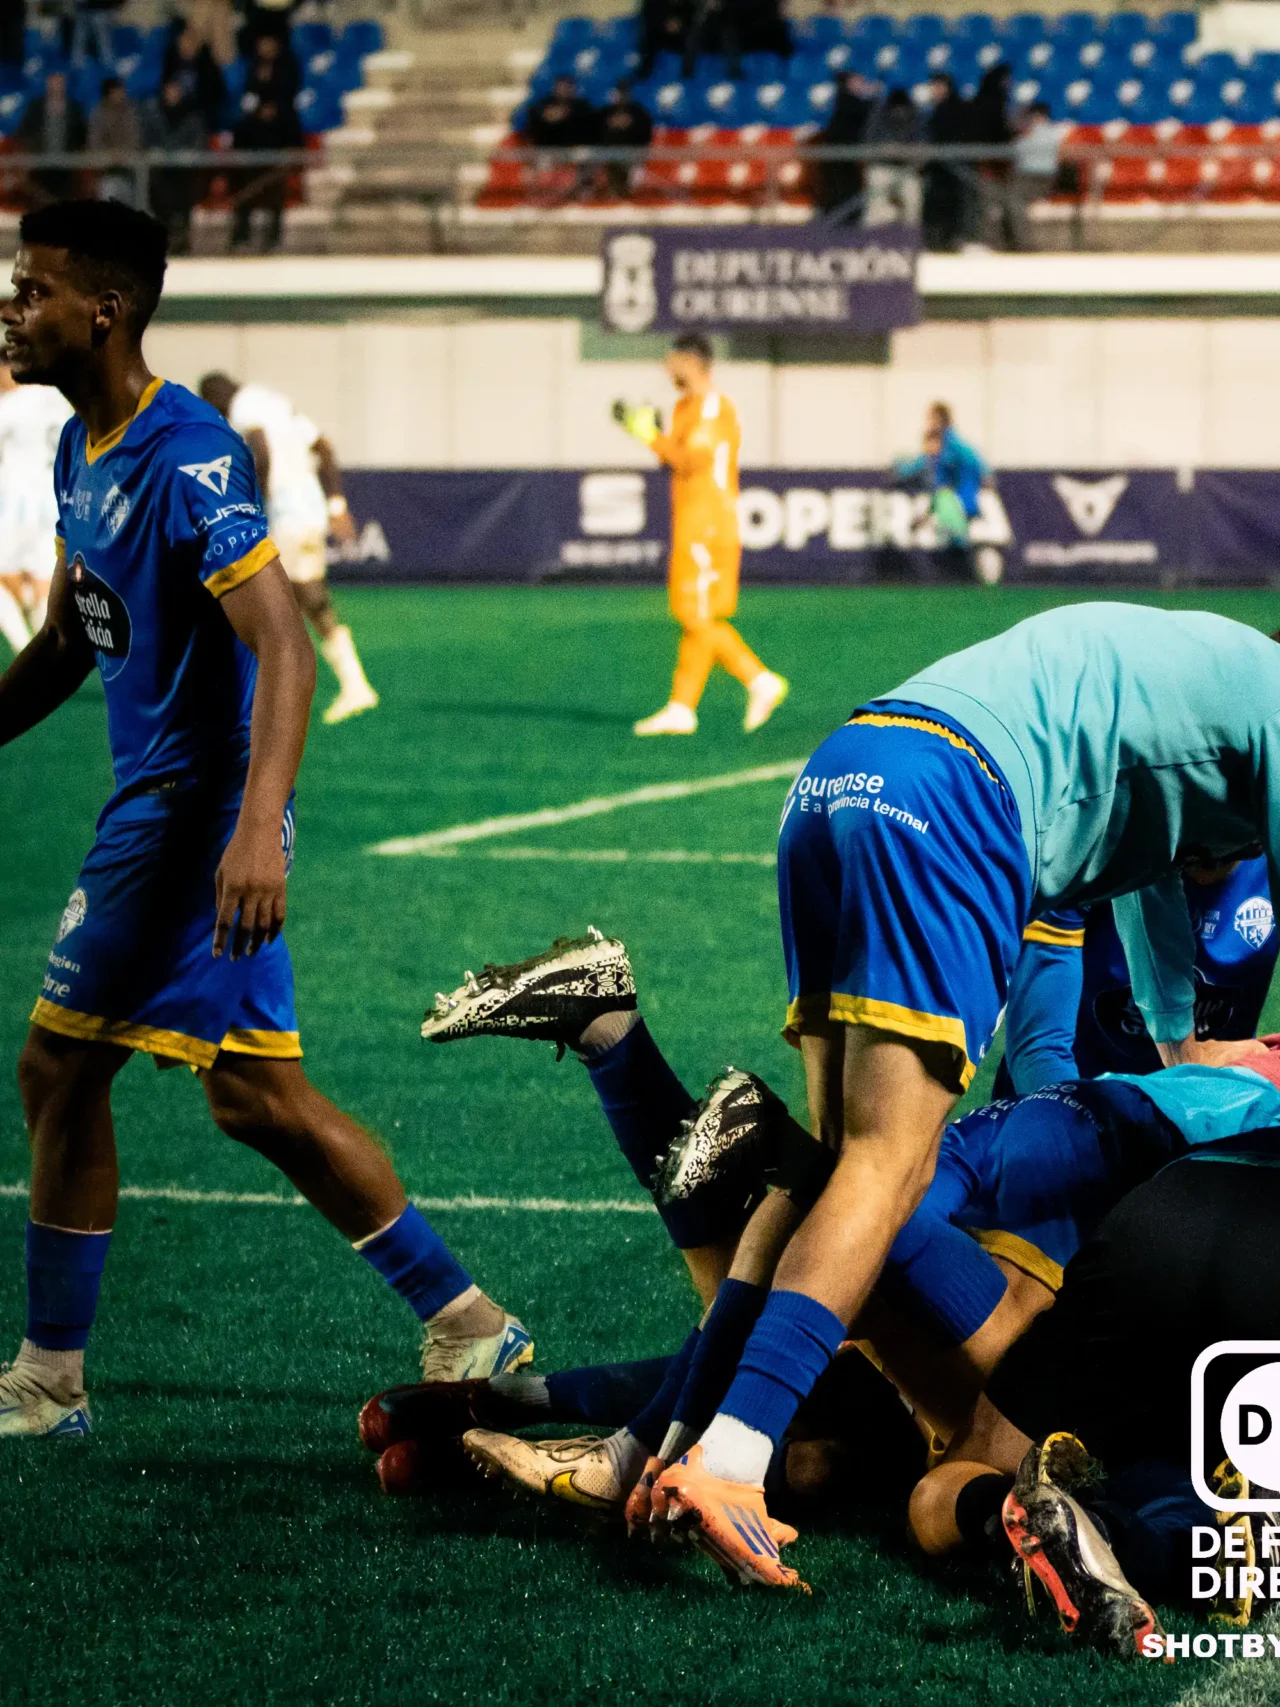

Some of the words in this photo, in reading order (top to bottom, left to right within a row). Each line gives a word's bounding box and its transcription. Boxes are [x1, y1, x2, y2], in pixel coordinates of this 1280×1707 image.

[671, 286, 848, 322] OURENSE
[798, 772, 885, 799] ourense
[813, 802, 822, 813] a
[827, 793, 870, 819] provincia
[872, 797, 930, 835] termal
